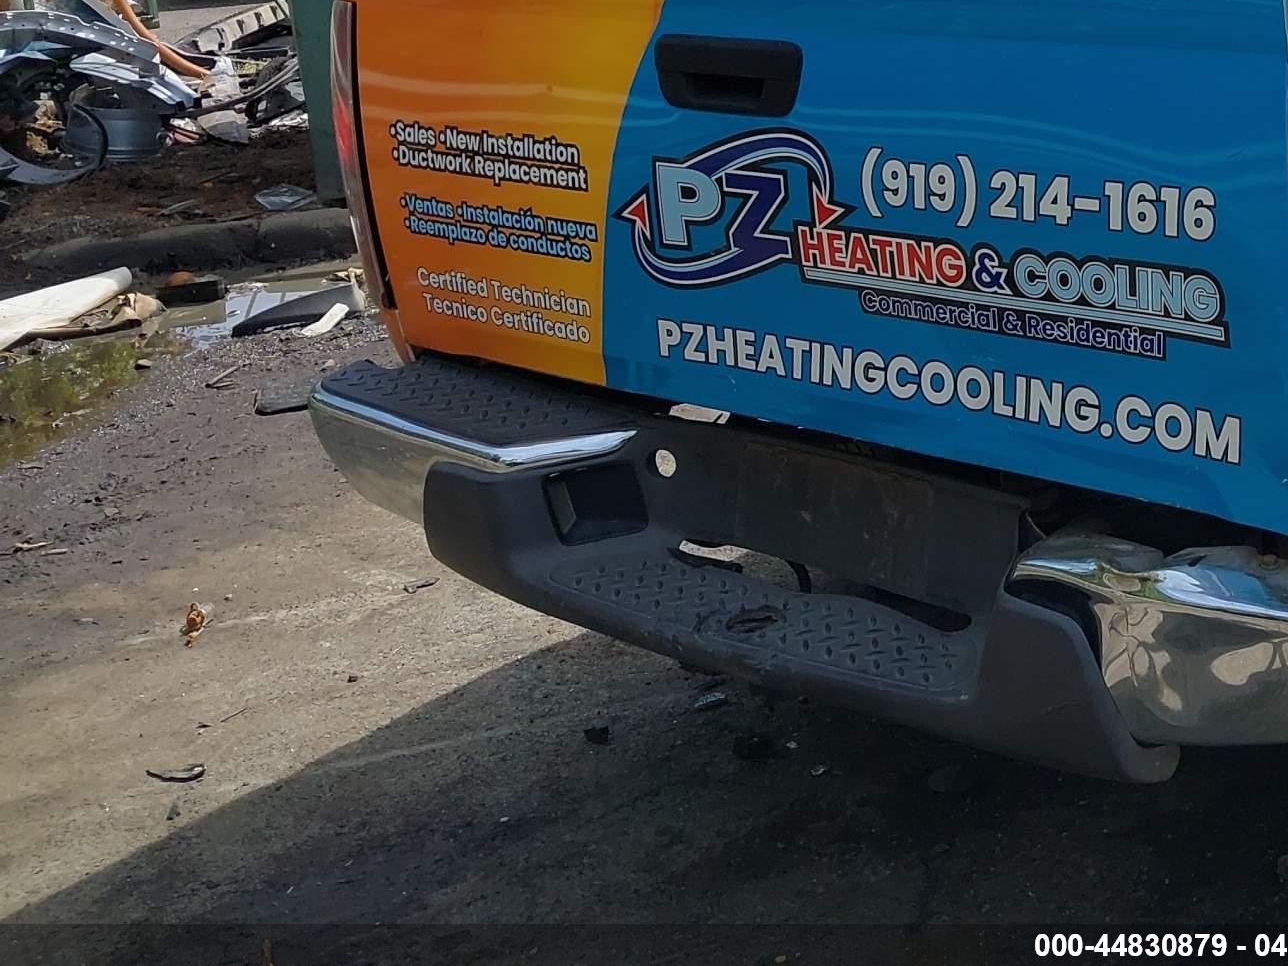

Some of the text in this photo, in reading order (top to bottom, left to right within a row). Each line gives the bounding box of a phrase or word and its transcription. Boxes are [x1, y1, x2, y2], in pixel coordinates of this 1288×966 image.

[474, 155, 588, 189] Replacement
[482, 134, 579, 164] Installation
[656, 162, 793, 262] PZ
[861, 147, 1216, 242] (919) 214-1616
[488, 228, 507, 248] de
[509, 233, 591, 261] conductos
[546, 217, 597, 241] nueva
[416, 266, 592, 318] Certified Technician
[798, 226, 1222, 321] HEATING & COOLING
[422, 292, 591, 344] Tecnico Certificado
[861, 288, 1164, 359] Commercial & Residential
[657, 320, 1242, 465] PZHEATINGCOOLING.COM
